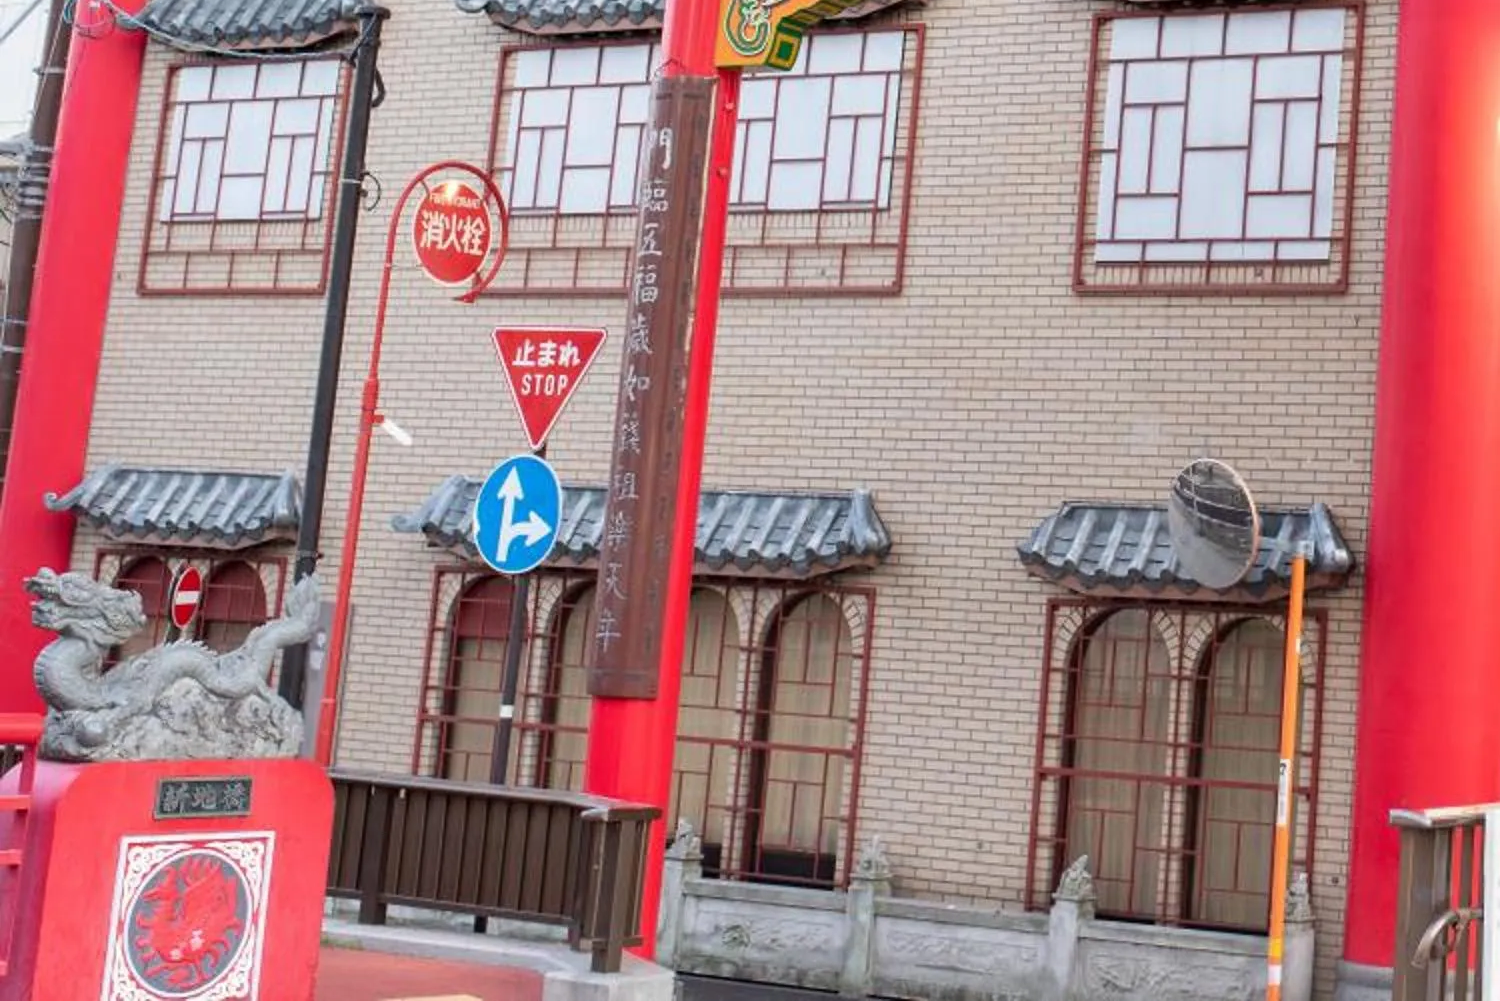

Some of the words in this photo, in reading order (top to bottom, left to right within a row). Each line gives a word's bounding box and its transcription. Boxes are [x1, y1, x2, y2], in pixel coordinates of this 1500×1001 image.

[420, 209, 486, 256] 消火栓
[512, 340, 580, 366] 止まれ
[521, 374, 569, 396] STOP
